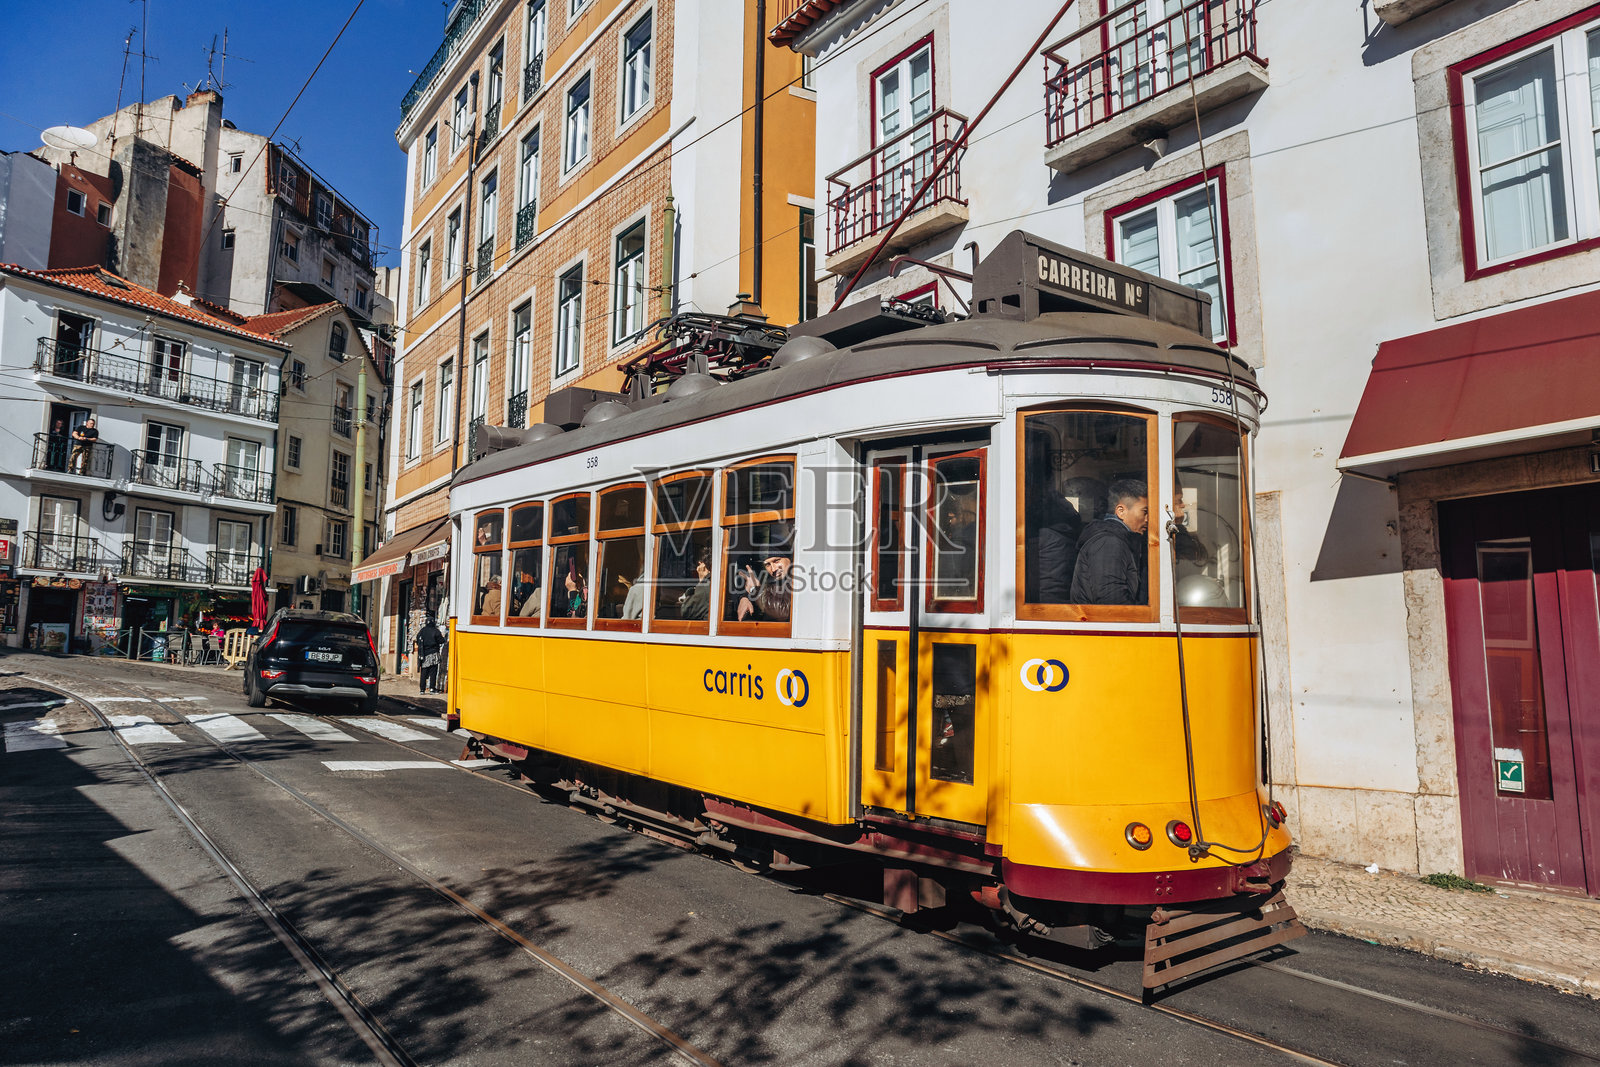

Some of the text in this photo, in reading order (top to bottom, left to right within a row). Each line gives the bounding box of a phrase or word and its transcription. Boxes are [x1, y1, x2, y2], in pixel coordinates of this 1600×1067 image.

[1038, 255, 1117, 301] CARREIRA
[1211, 387, 1232, 406] 558
[586, 456, 598, 469] 558
[703, 663, 764, 700] carris
